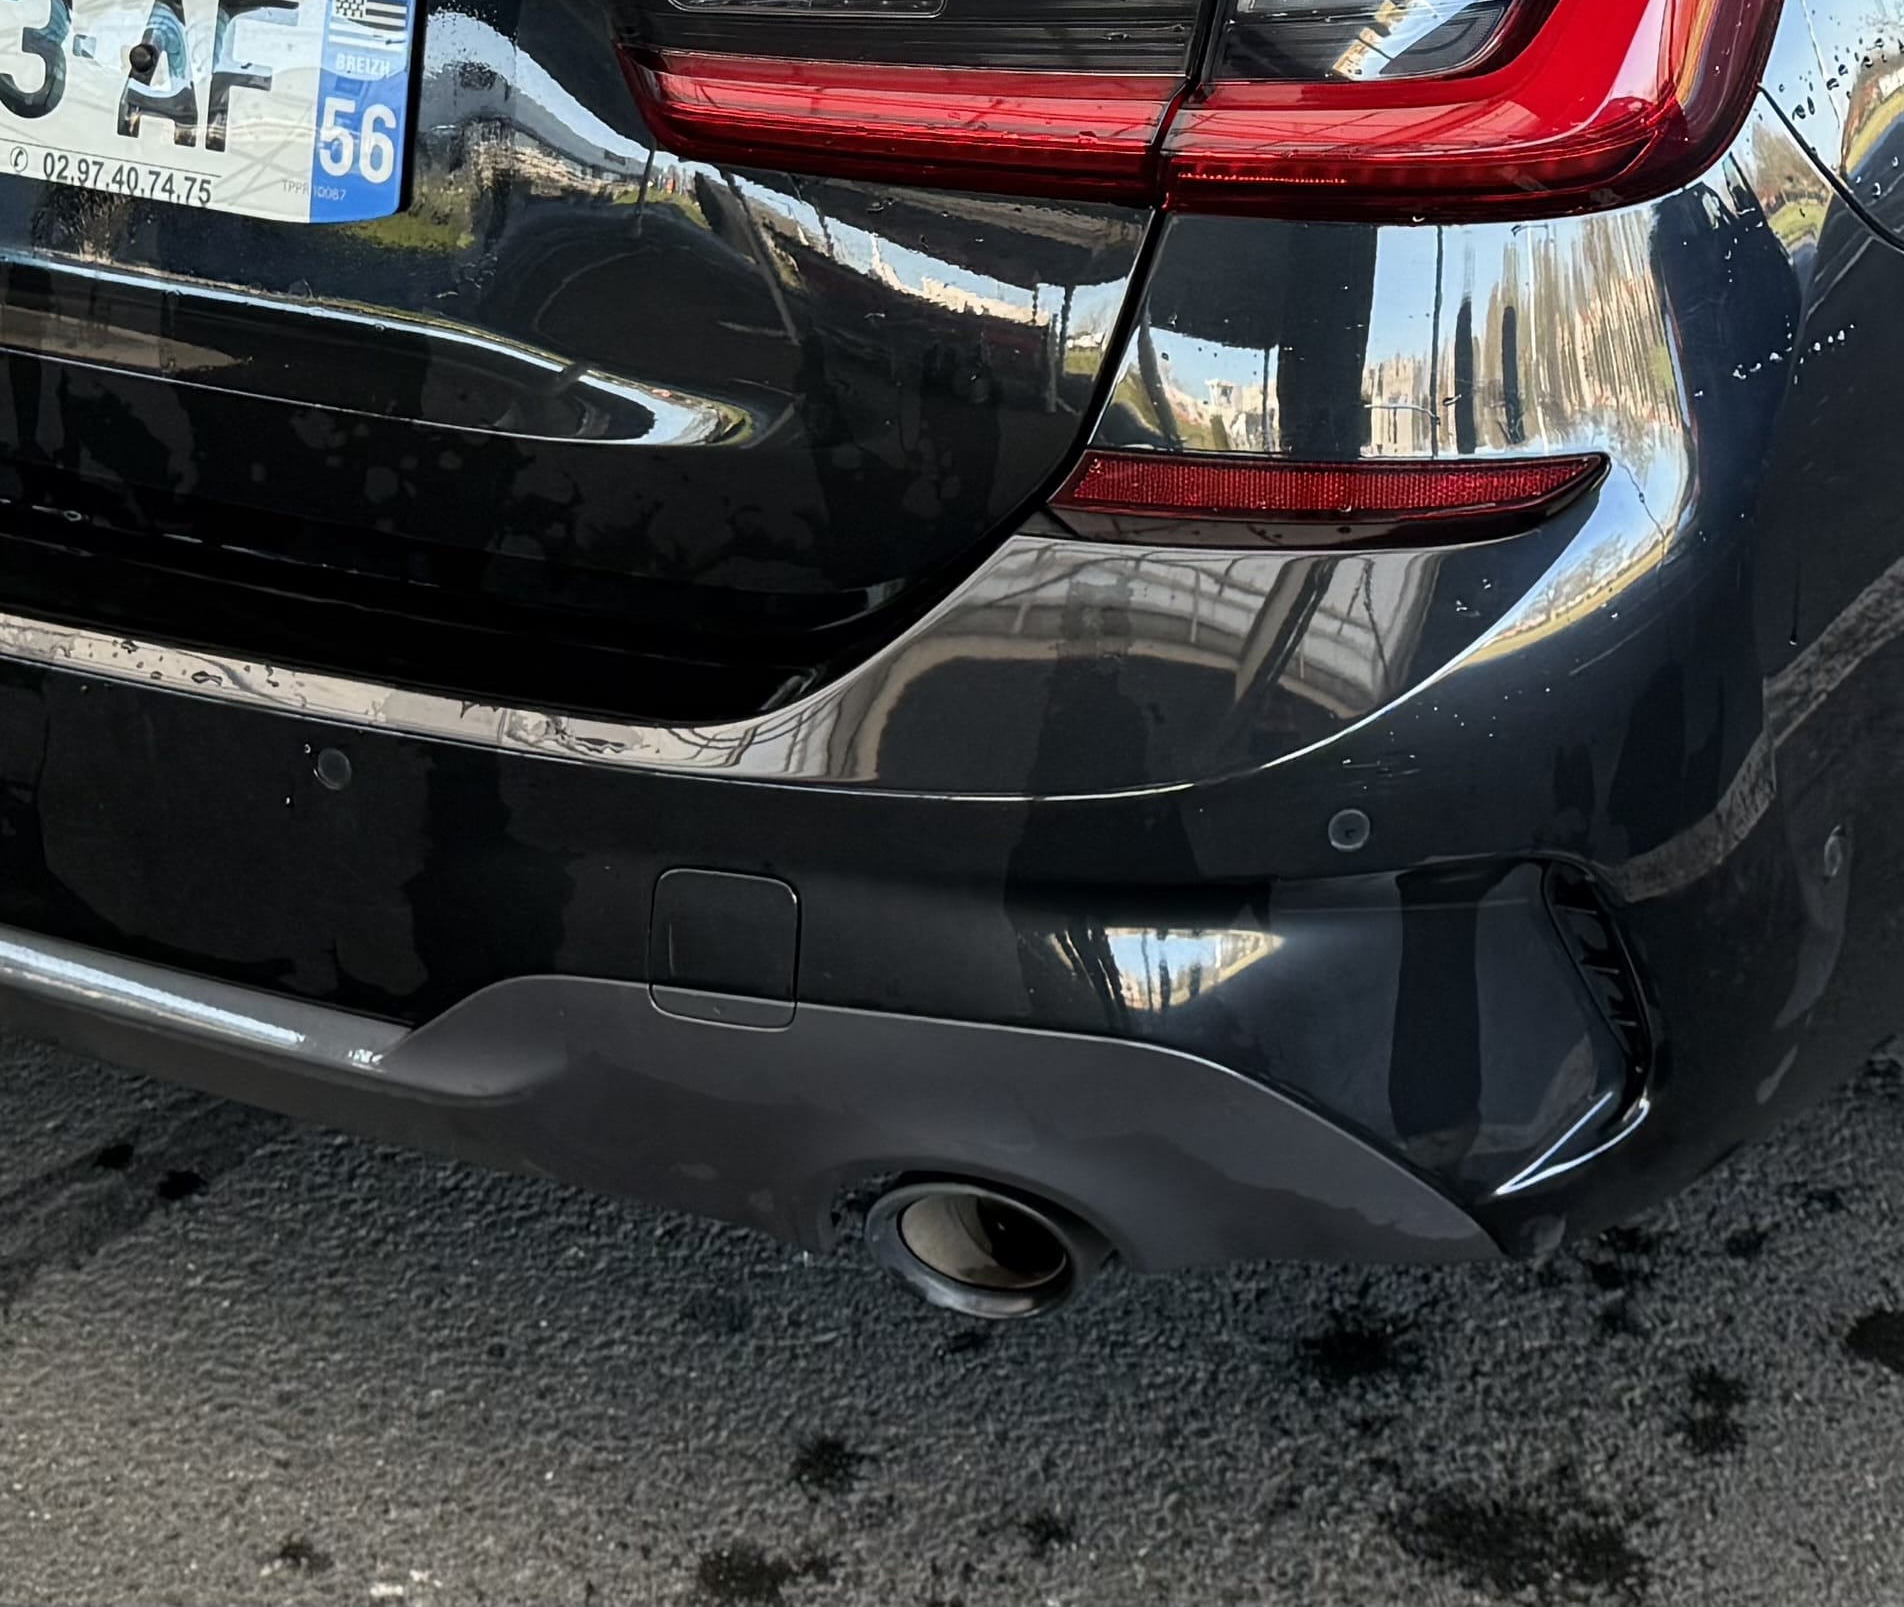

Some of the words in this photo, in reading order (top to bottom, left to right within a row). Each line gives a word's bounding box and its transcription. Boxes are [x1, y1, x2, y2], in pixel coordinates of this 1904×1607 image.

[335, 51, 392, 78] BREIZH
[318, 96, 398, 185] 56
[42, 150, 214, 208] 02.97.40.74.75
